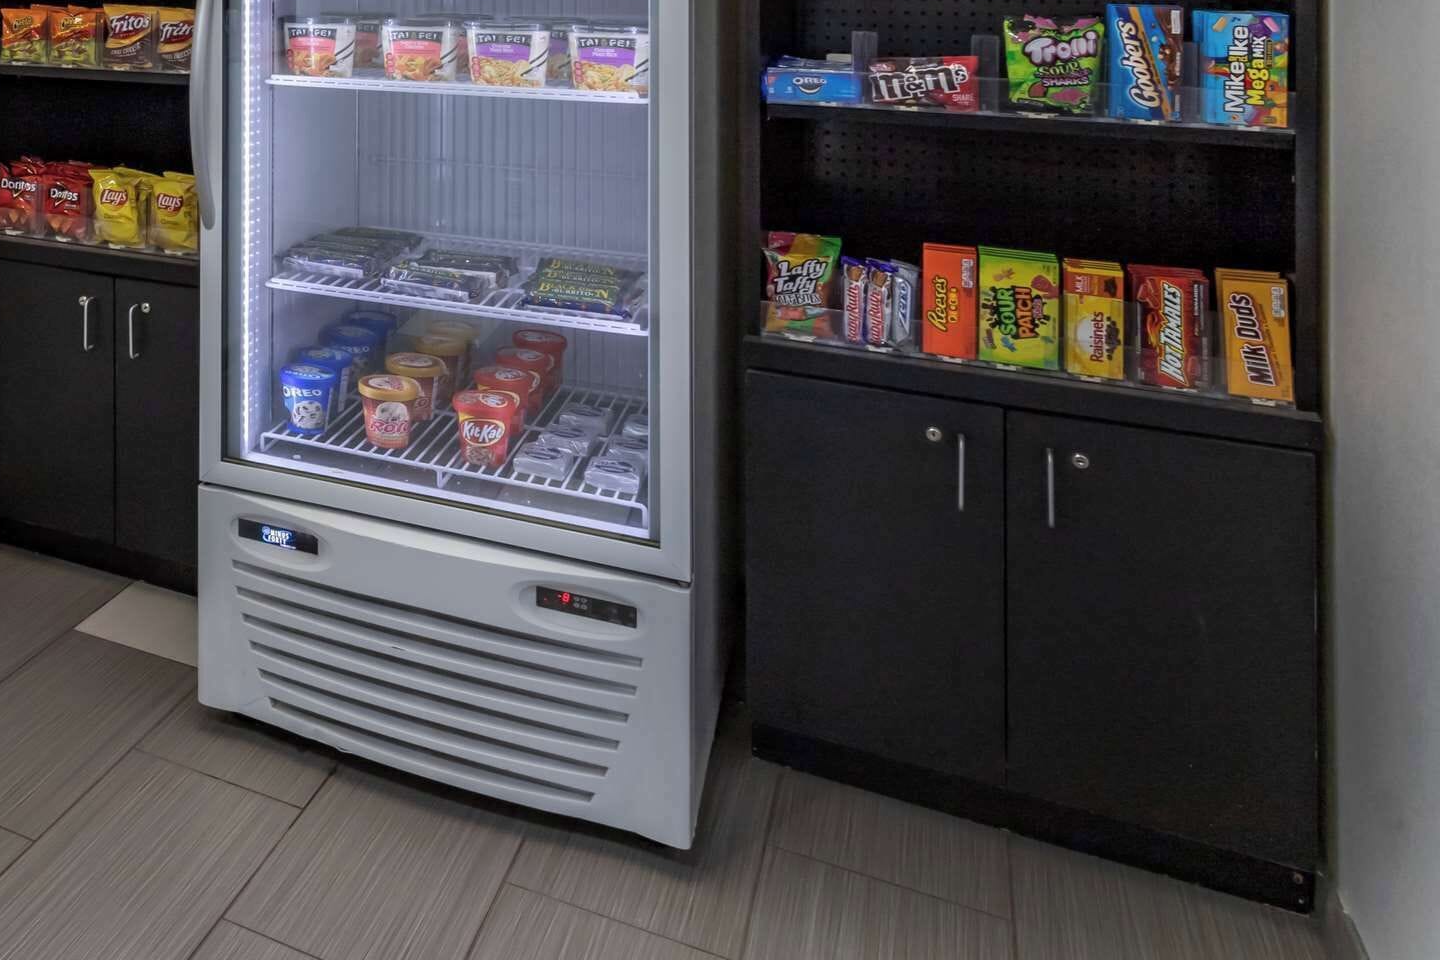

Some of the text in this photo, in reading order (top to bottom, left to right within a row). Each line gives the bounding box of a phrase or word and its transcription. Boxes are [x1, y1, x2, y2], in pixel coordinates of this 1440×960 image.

[110, 15, 151, 34] Fritos
[161, 22, 193, 41] Frit
[580, 39, 599, 47] TAI
[1024, 31, 1097, 65] Trolli
[1233, 25, 1249, 55] Ike
[1040, 61, 1080, 76] SOUR
[1118, 19, 1160, 108] Goobers
[1225, 62, 1245, 112] Mike
[1246, 59, 1269, 105] Mega
[0, 178, 36, 192] Doritos
[50, 188, 78, 201] Doritos
[778, 260, 827, 279] Laffy
[773, 277, 816, 294] Taffy
[847, 284, 859, 311] Ruth
[869, 290, 881, 315] Ruth
[928, 276, 948, 332] Reese's
[997, 288, 1017, 335] SOUR
[1015, 287, 1034, 338] PATCH
[1089, 311, 1104, 362] Raisinets
[1160, 283, 1185, 382] HOT TAMALES
[1228, 294, 1276, 386] Milk Duds
[282, 384, 322, 397] OREO
